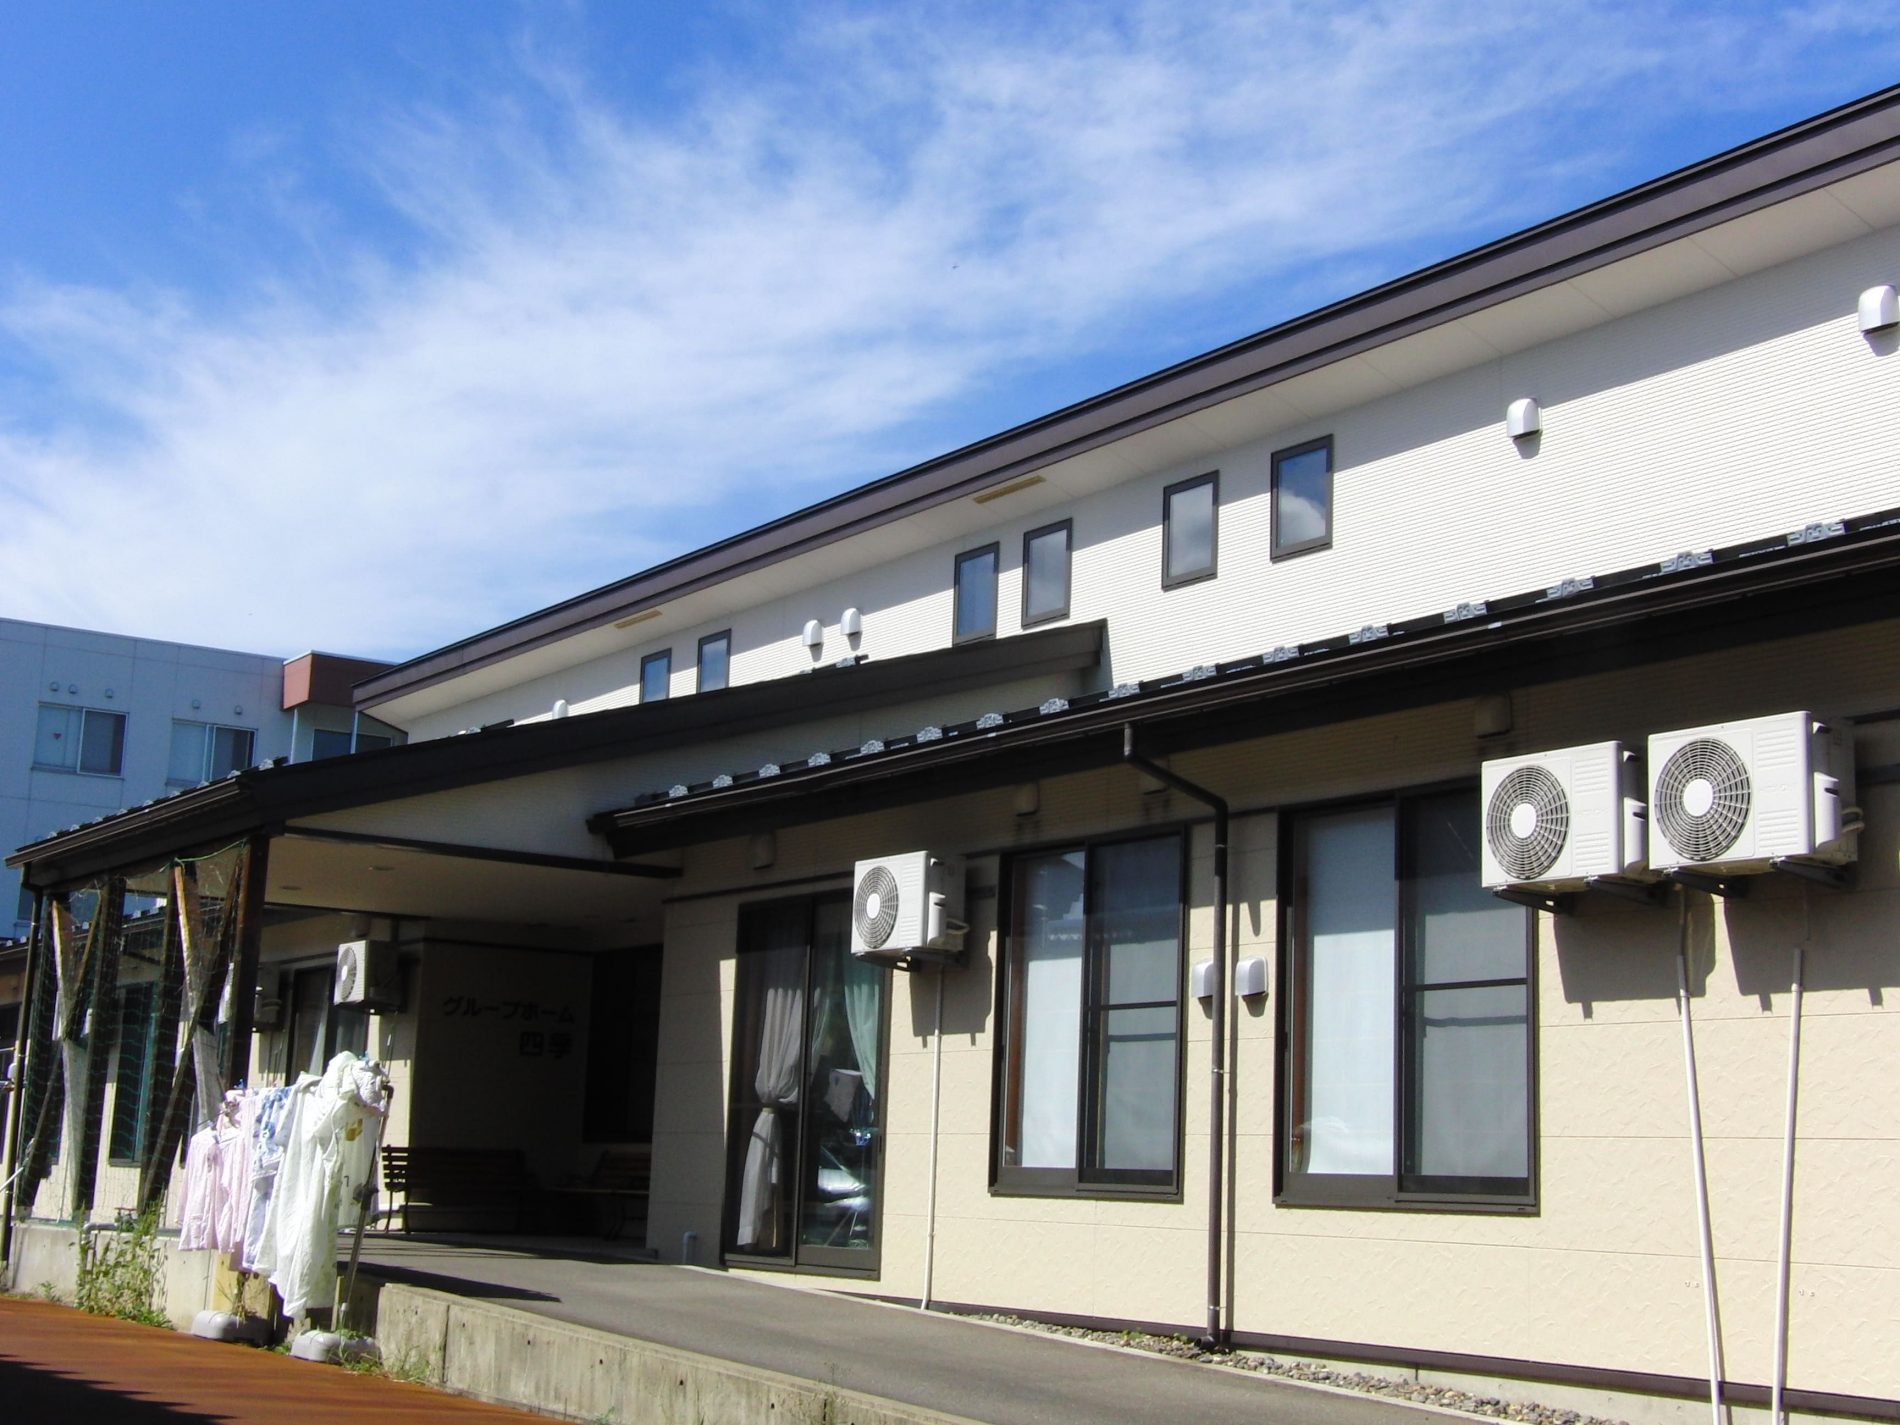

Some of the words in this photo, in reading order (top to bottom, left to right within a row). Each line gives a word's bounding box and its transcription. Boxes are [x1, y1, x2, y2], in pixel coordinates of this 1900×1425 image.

[443, 995, 576, 1025] グループホーム
